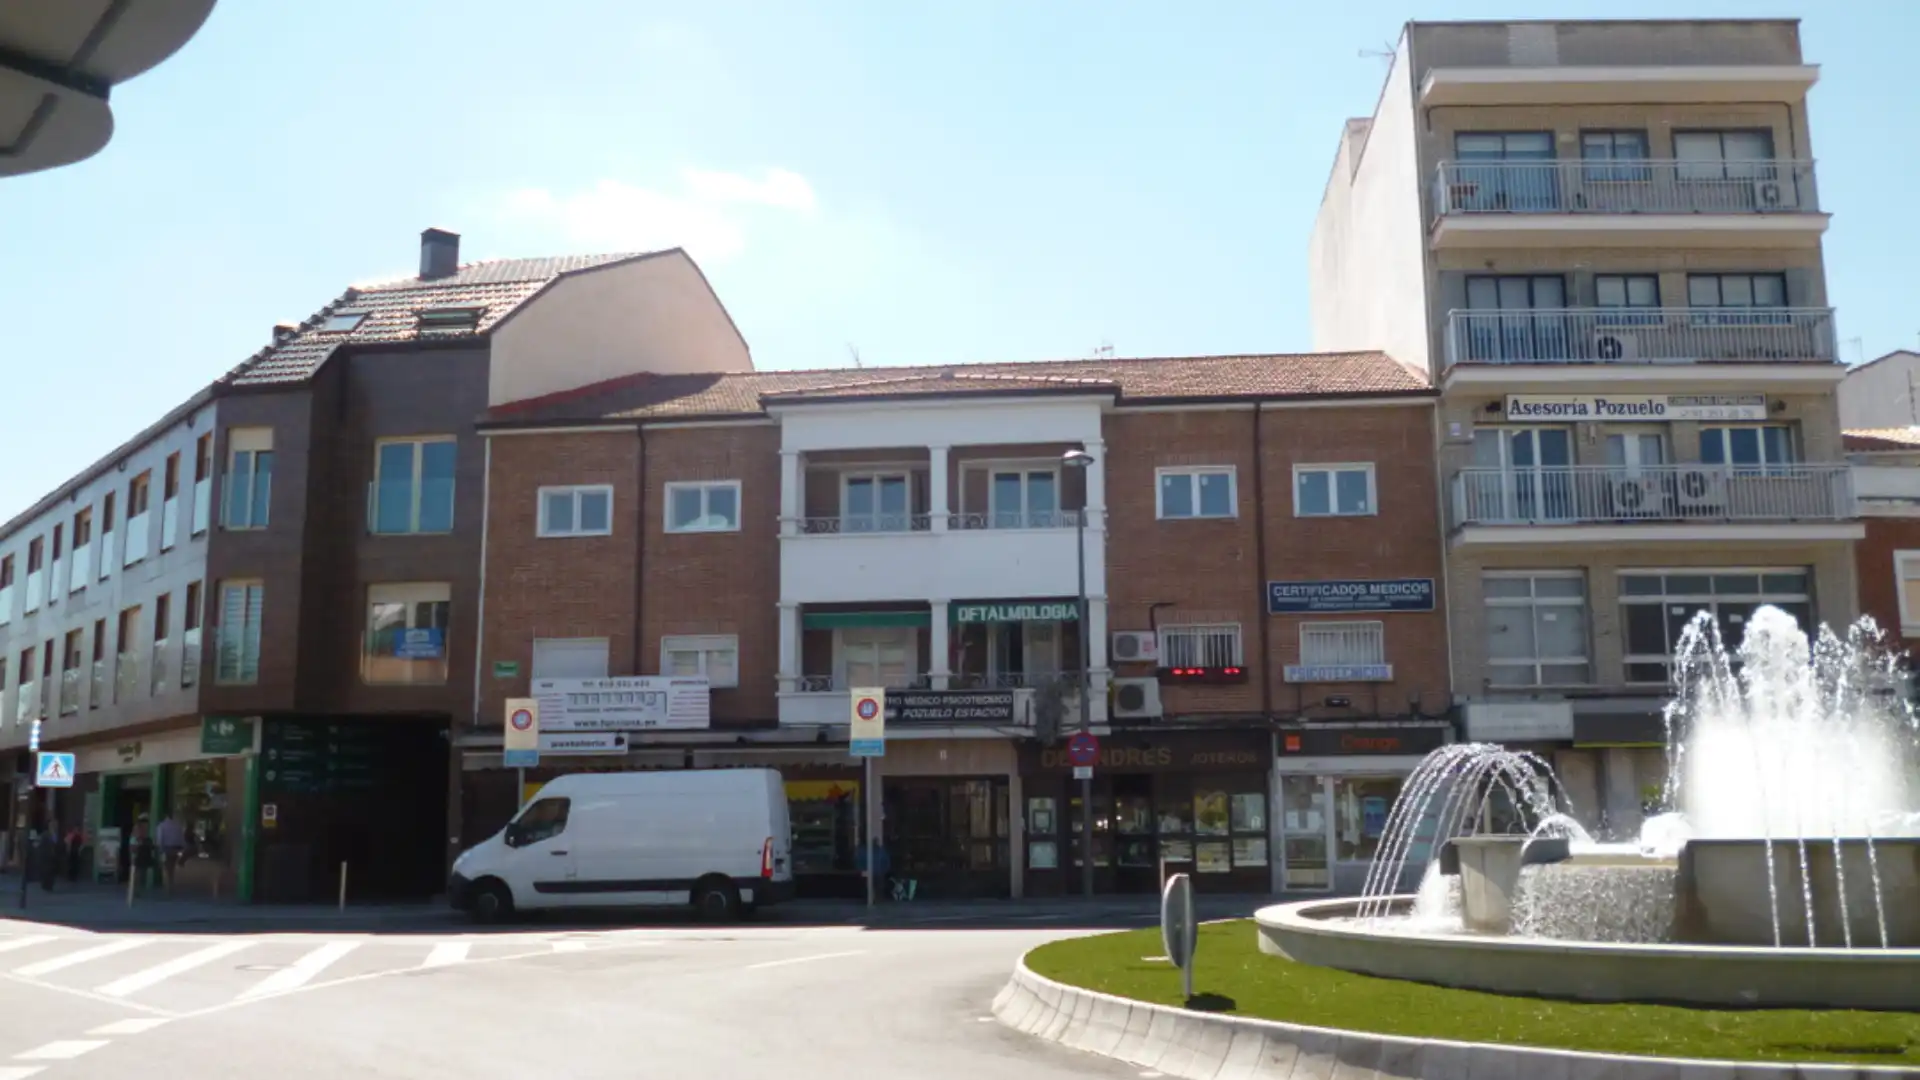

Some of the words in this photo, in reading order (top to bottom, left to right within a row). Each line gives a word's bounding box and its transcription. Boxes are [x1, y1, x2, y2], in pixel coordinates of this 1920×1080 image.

[1508, 397, 1589, 416] Asesoría
[1594, 398, 1666, 416] Pozuelo
[1273, 583, 1367, 597] CERTIFICADOS
[1369, 582, 1430, 596] MEDICOS
[957, 603, 1079, 622] OFTALMOLOGIA
[904, 695, 941, 706] MEDICO
[902, 707, 952, 719] POZUELO
[954, 706, 1009, 719] ESTACION
[1096, 746, 1173, 766] NDRES
